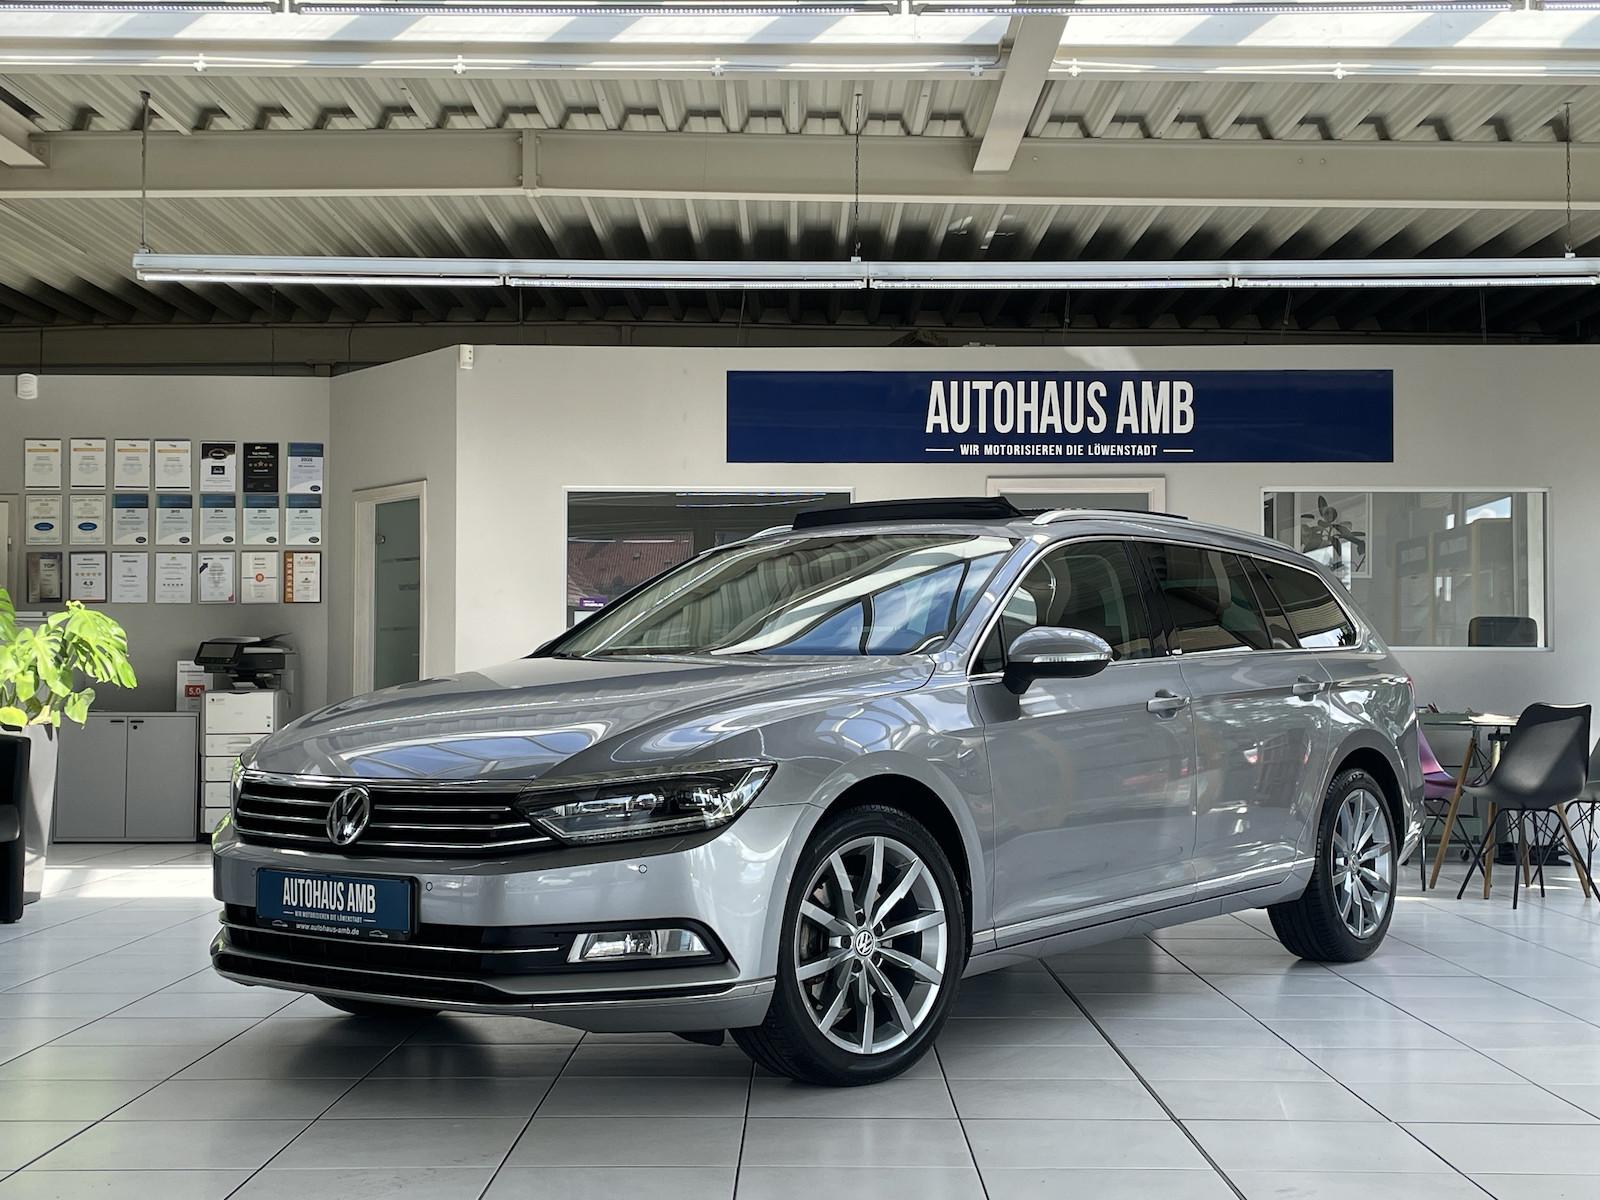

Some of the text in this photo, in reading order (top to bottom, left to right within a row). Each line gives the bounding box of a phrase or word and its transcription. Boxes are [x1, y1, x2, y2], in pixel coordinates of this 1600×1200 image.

[925, 380, 1194, 435] AUTOHAUS AMB
[960, 442, 1158, 457] WIR MOTORISIEREN DIE LÖWENSTADT
[283, 877, 376, 914] AUTOHAUS AMB
[295, 923, 360, 936] www.autohaus-amb.de
